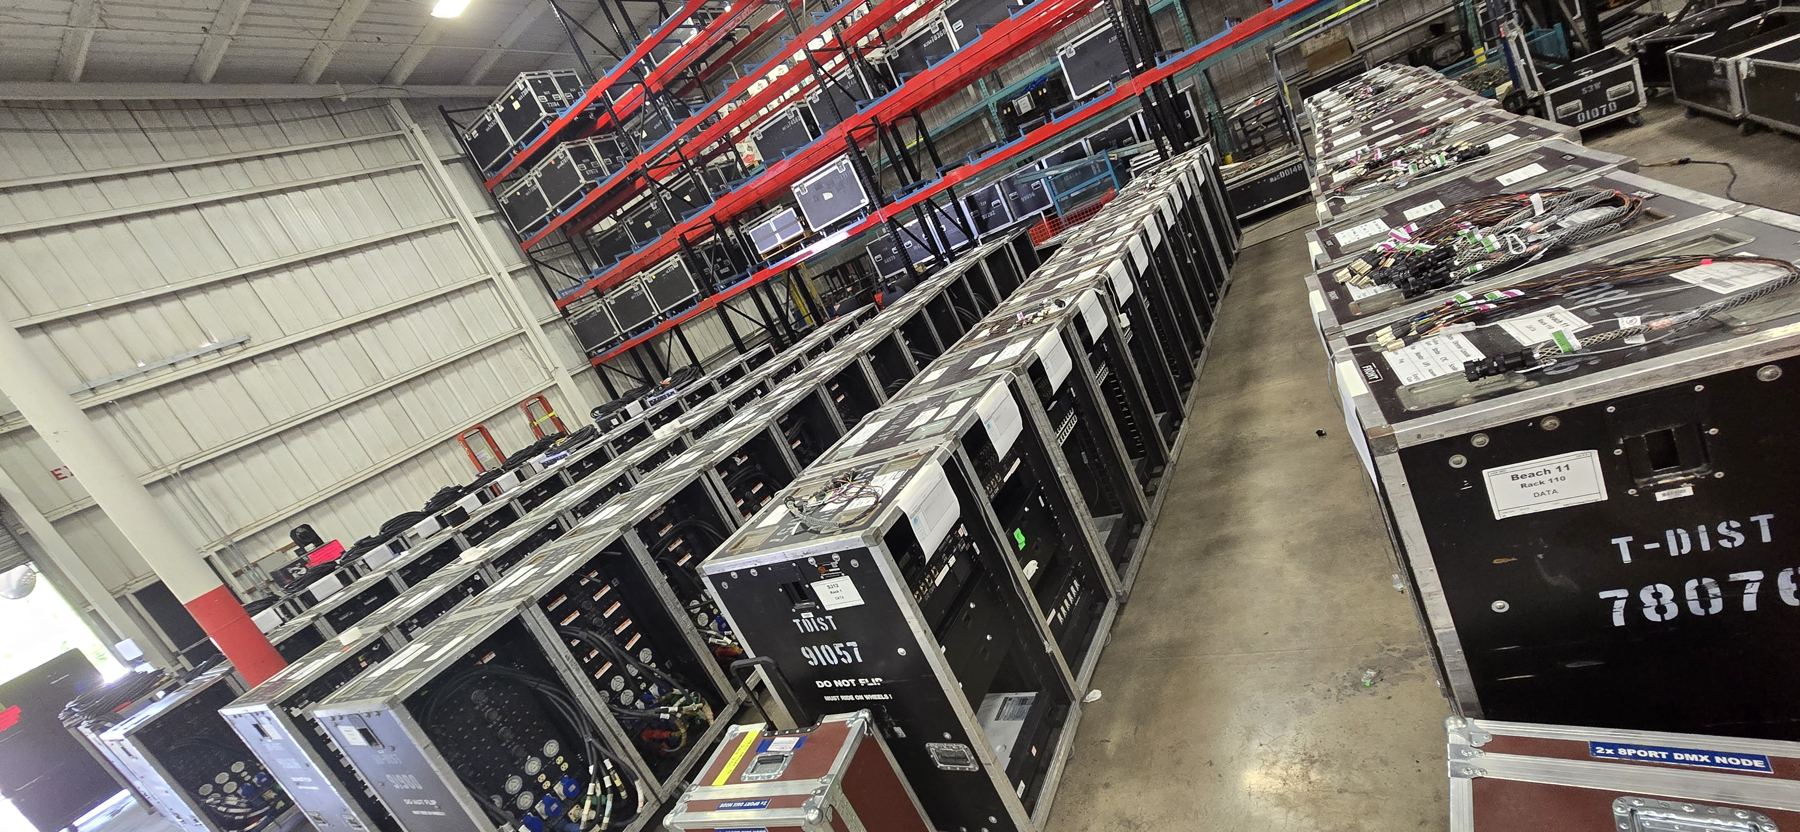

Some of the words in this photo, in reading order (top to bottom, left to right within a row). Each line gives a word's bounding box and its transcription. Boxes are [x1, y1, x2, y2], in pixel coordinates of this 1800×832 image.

[1361, 364, 1379, 380] FRONT
[1511, 468, 1551, 481] Beach
[1555, 464, 1570, 473] 11
[1520, 480, 1545, 489] Rack
[1548, 475, 1566, 484] 110
[1533, 489, 1559, 498] DATA
[1611, 514, 1775, 564] T-DIST
[793, 616, 837, 633] TDIST
[801, 641, 862, 666] 91057
[815, 680, 832, 688] DO
[833, 679, 856, 688] NOT
[858, 677, 883, 687] FLIP
[1595, 746, 1615, 756] 2x
[1618, 748, 1669, 760] 8PORT
[1673, 752, 1711, 763] DMX
[1715, 755, 1766, 768] NODE
